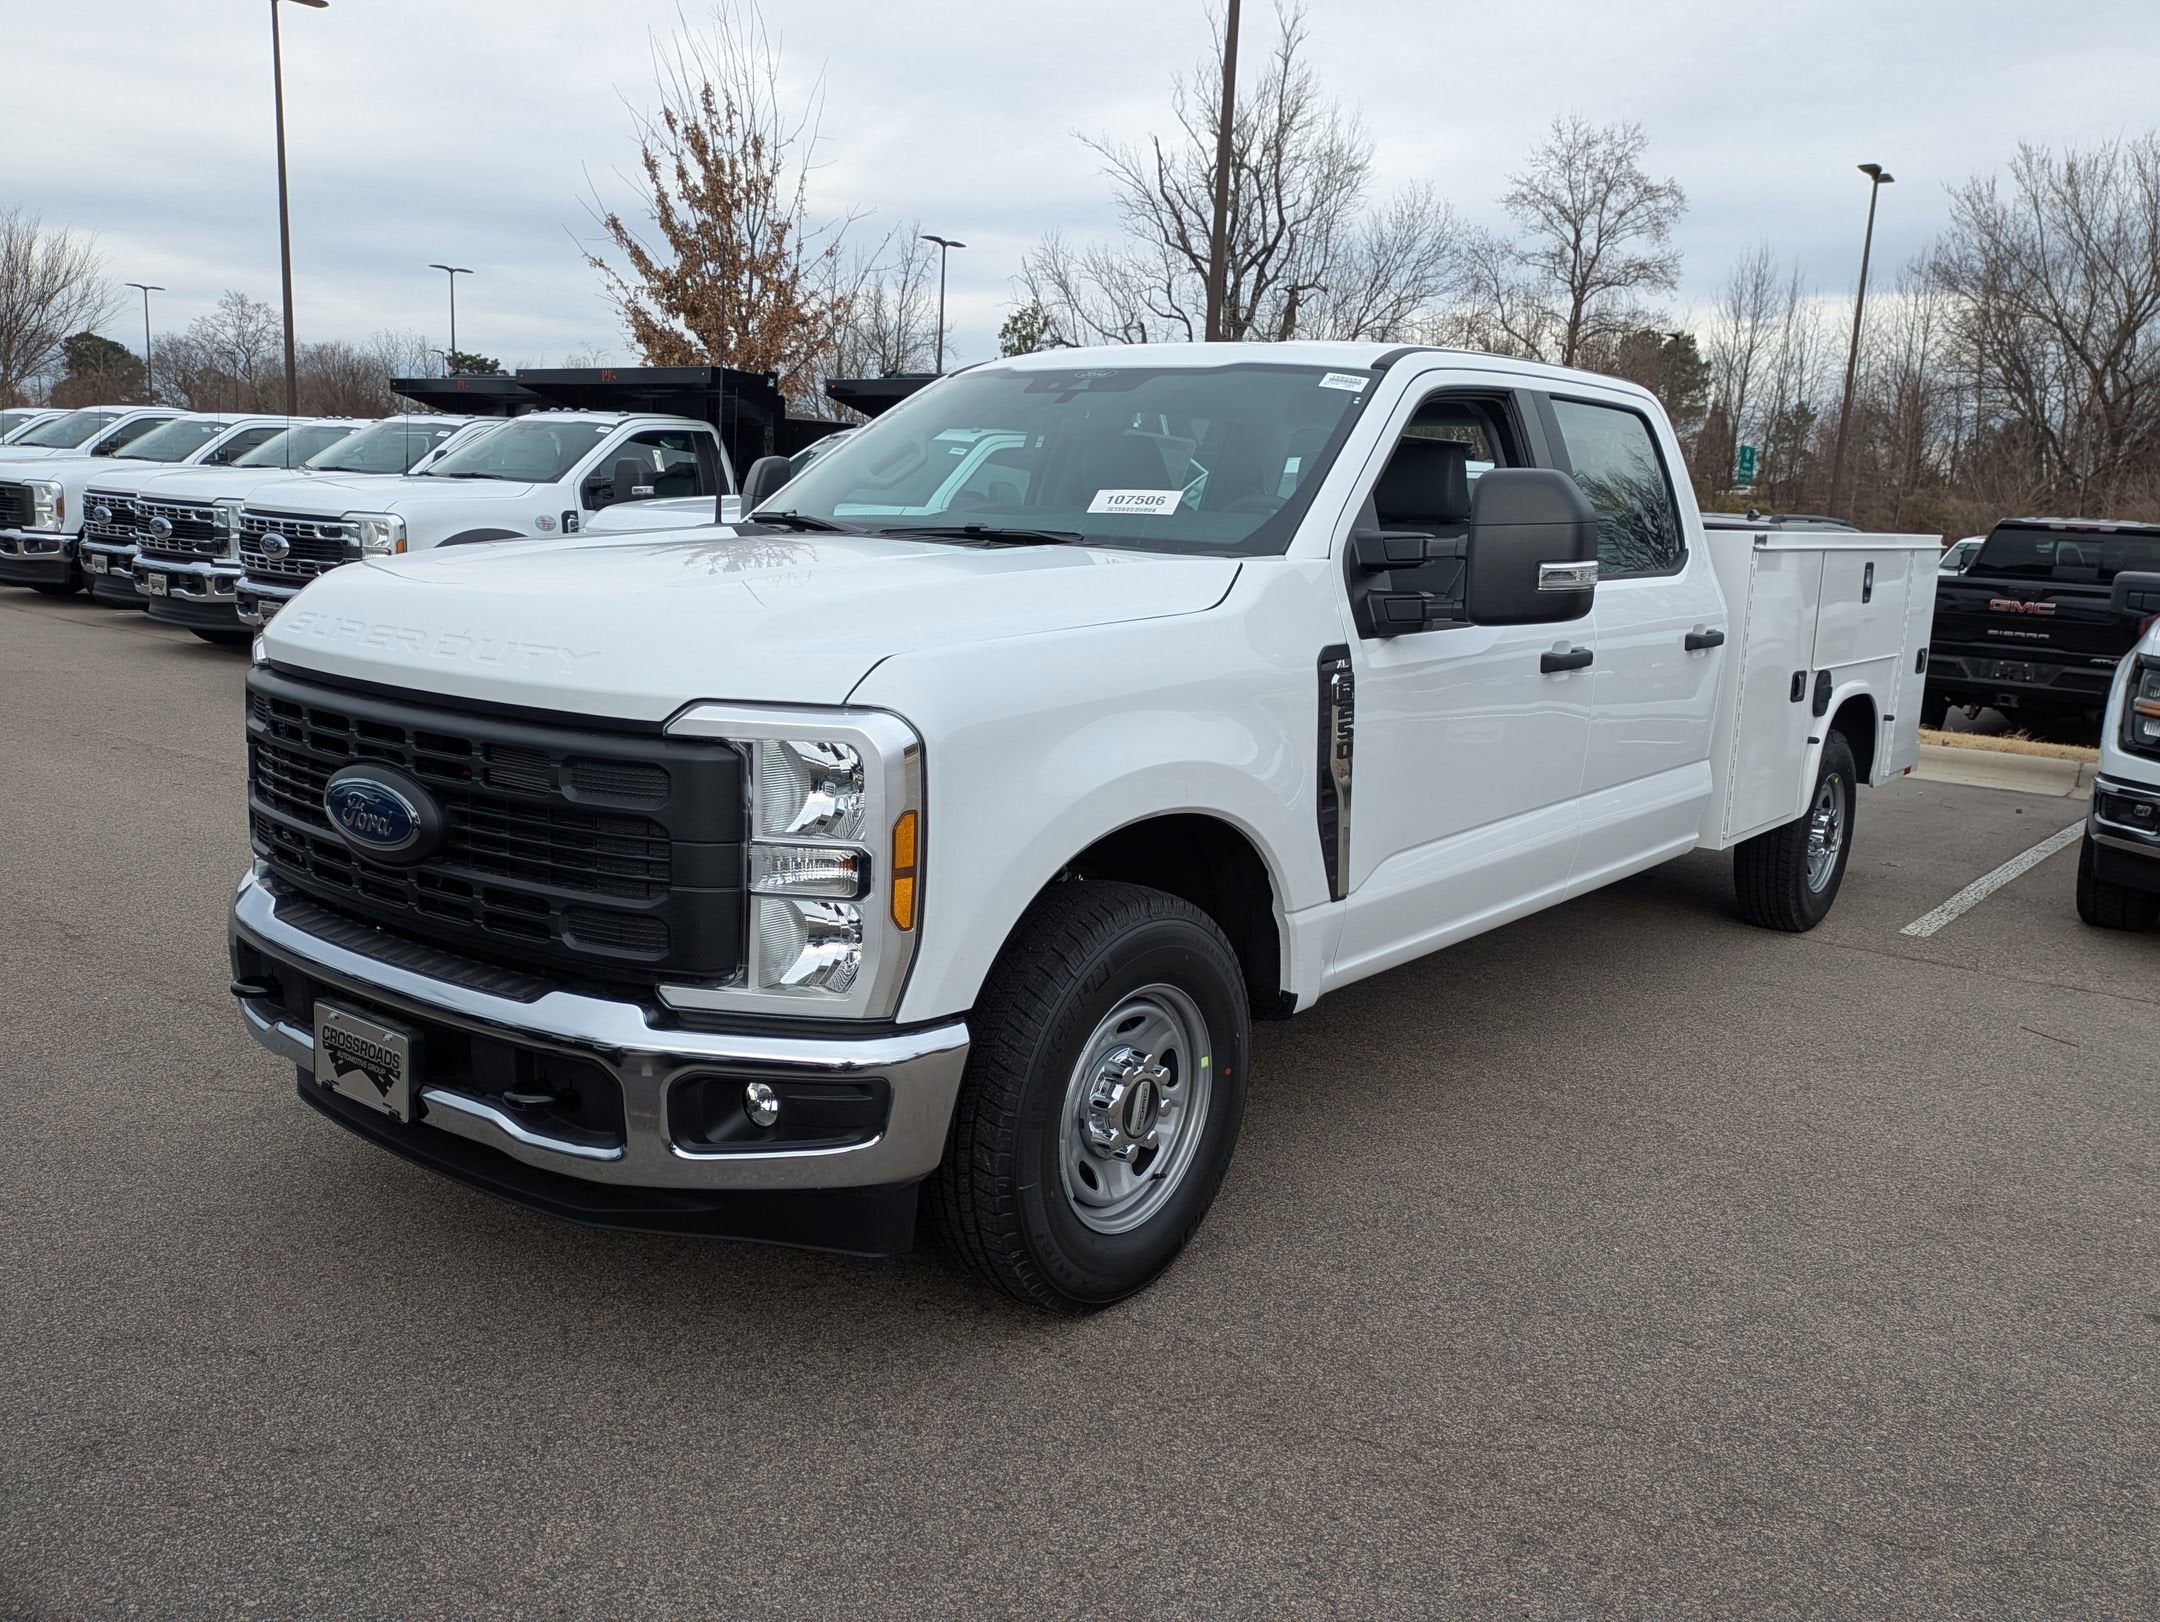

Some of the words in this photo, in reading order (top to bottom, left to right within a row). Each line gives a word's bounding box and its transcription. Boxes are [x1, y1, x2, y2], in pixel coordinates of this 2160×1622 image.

[1106, 495, 1166, 506] 107506
[1990, 599, 2056, 615] GMC
[287, 611, 428, 655] SUPER
[429, 633, 602, 674] DUTY
[1987, 629, 2050, 639] SIERRA
[1336, 659, 1349, 669] XL
[341, 791, 393, 837] Ford
[322, 1025, 400, 1069] CROSSROADS
[336, 1050, 367, 1069] AUTOMOTIVE
[368, 1062, 386, 1075] GROUP
